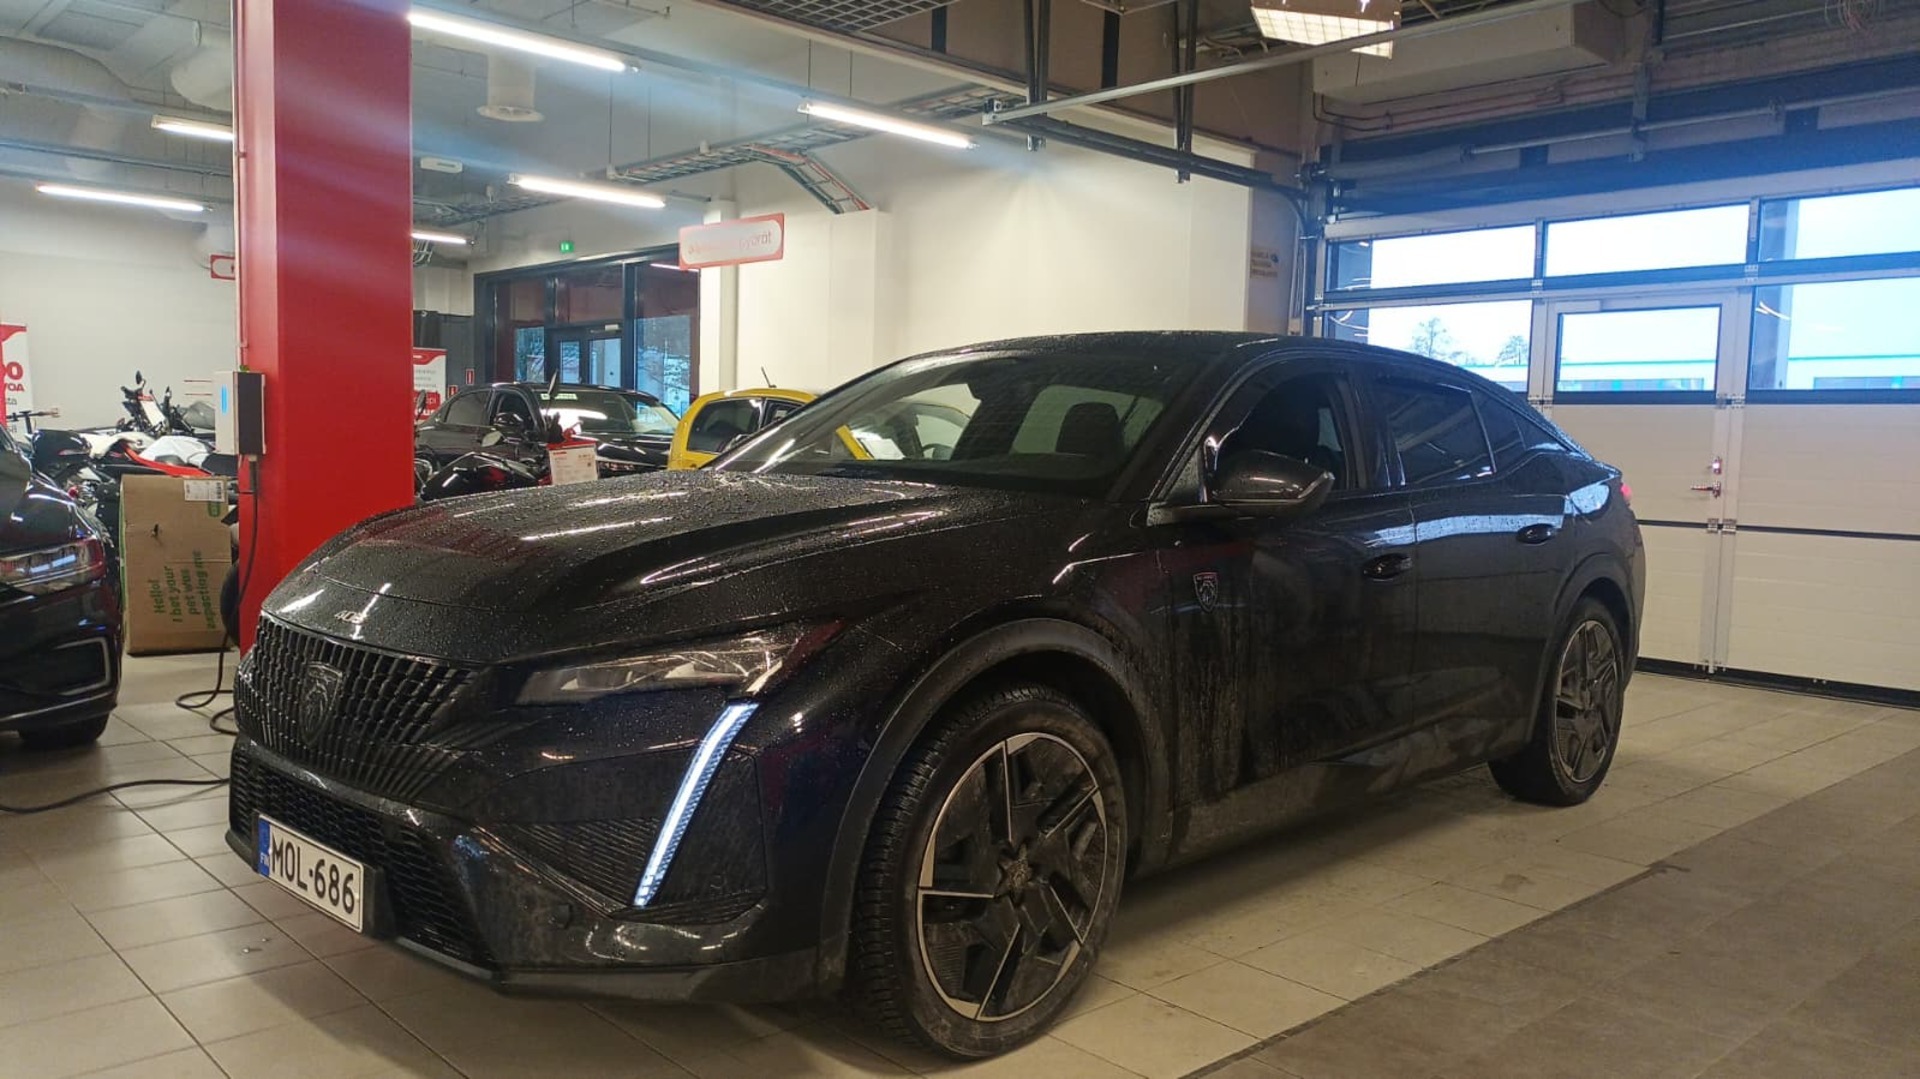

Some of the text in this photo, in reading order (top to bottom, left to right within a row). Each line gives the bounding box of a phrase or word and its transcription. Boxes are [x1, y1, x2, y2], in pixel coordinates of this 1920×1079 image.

[148, 579, 166, 614] Hello!
[164, 565, 181, 594] your
[181, 568, 201, 616] pet was
[195, 570, 217, 630] expecting
[170, 597, 182, 617] bet
[271, 832, 355, 915] MOL-686
